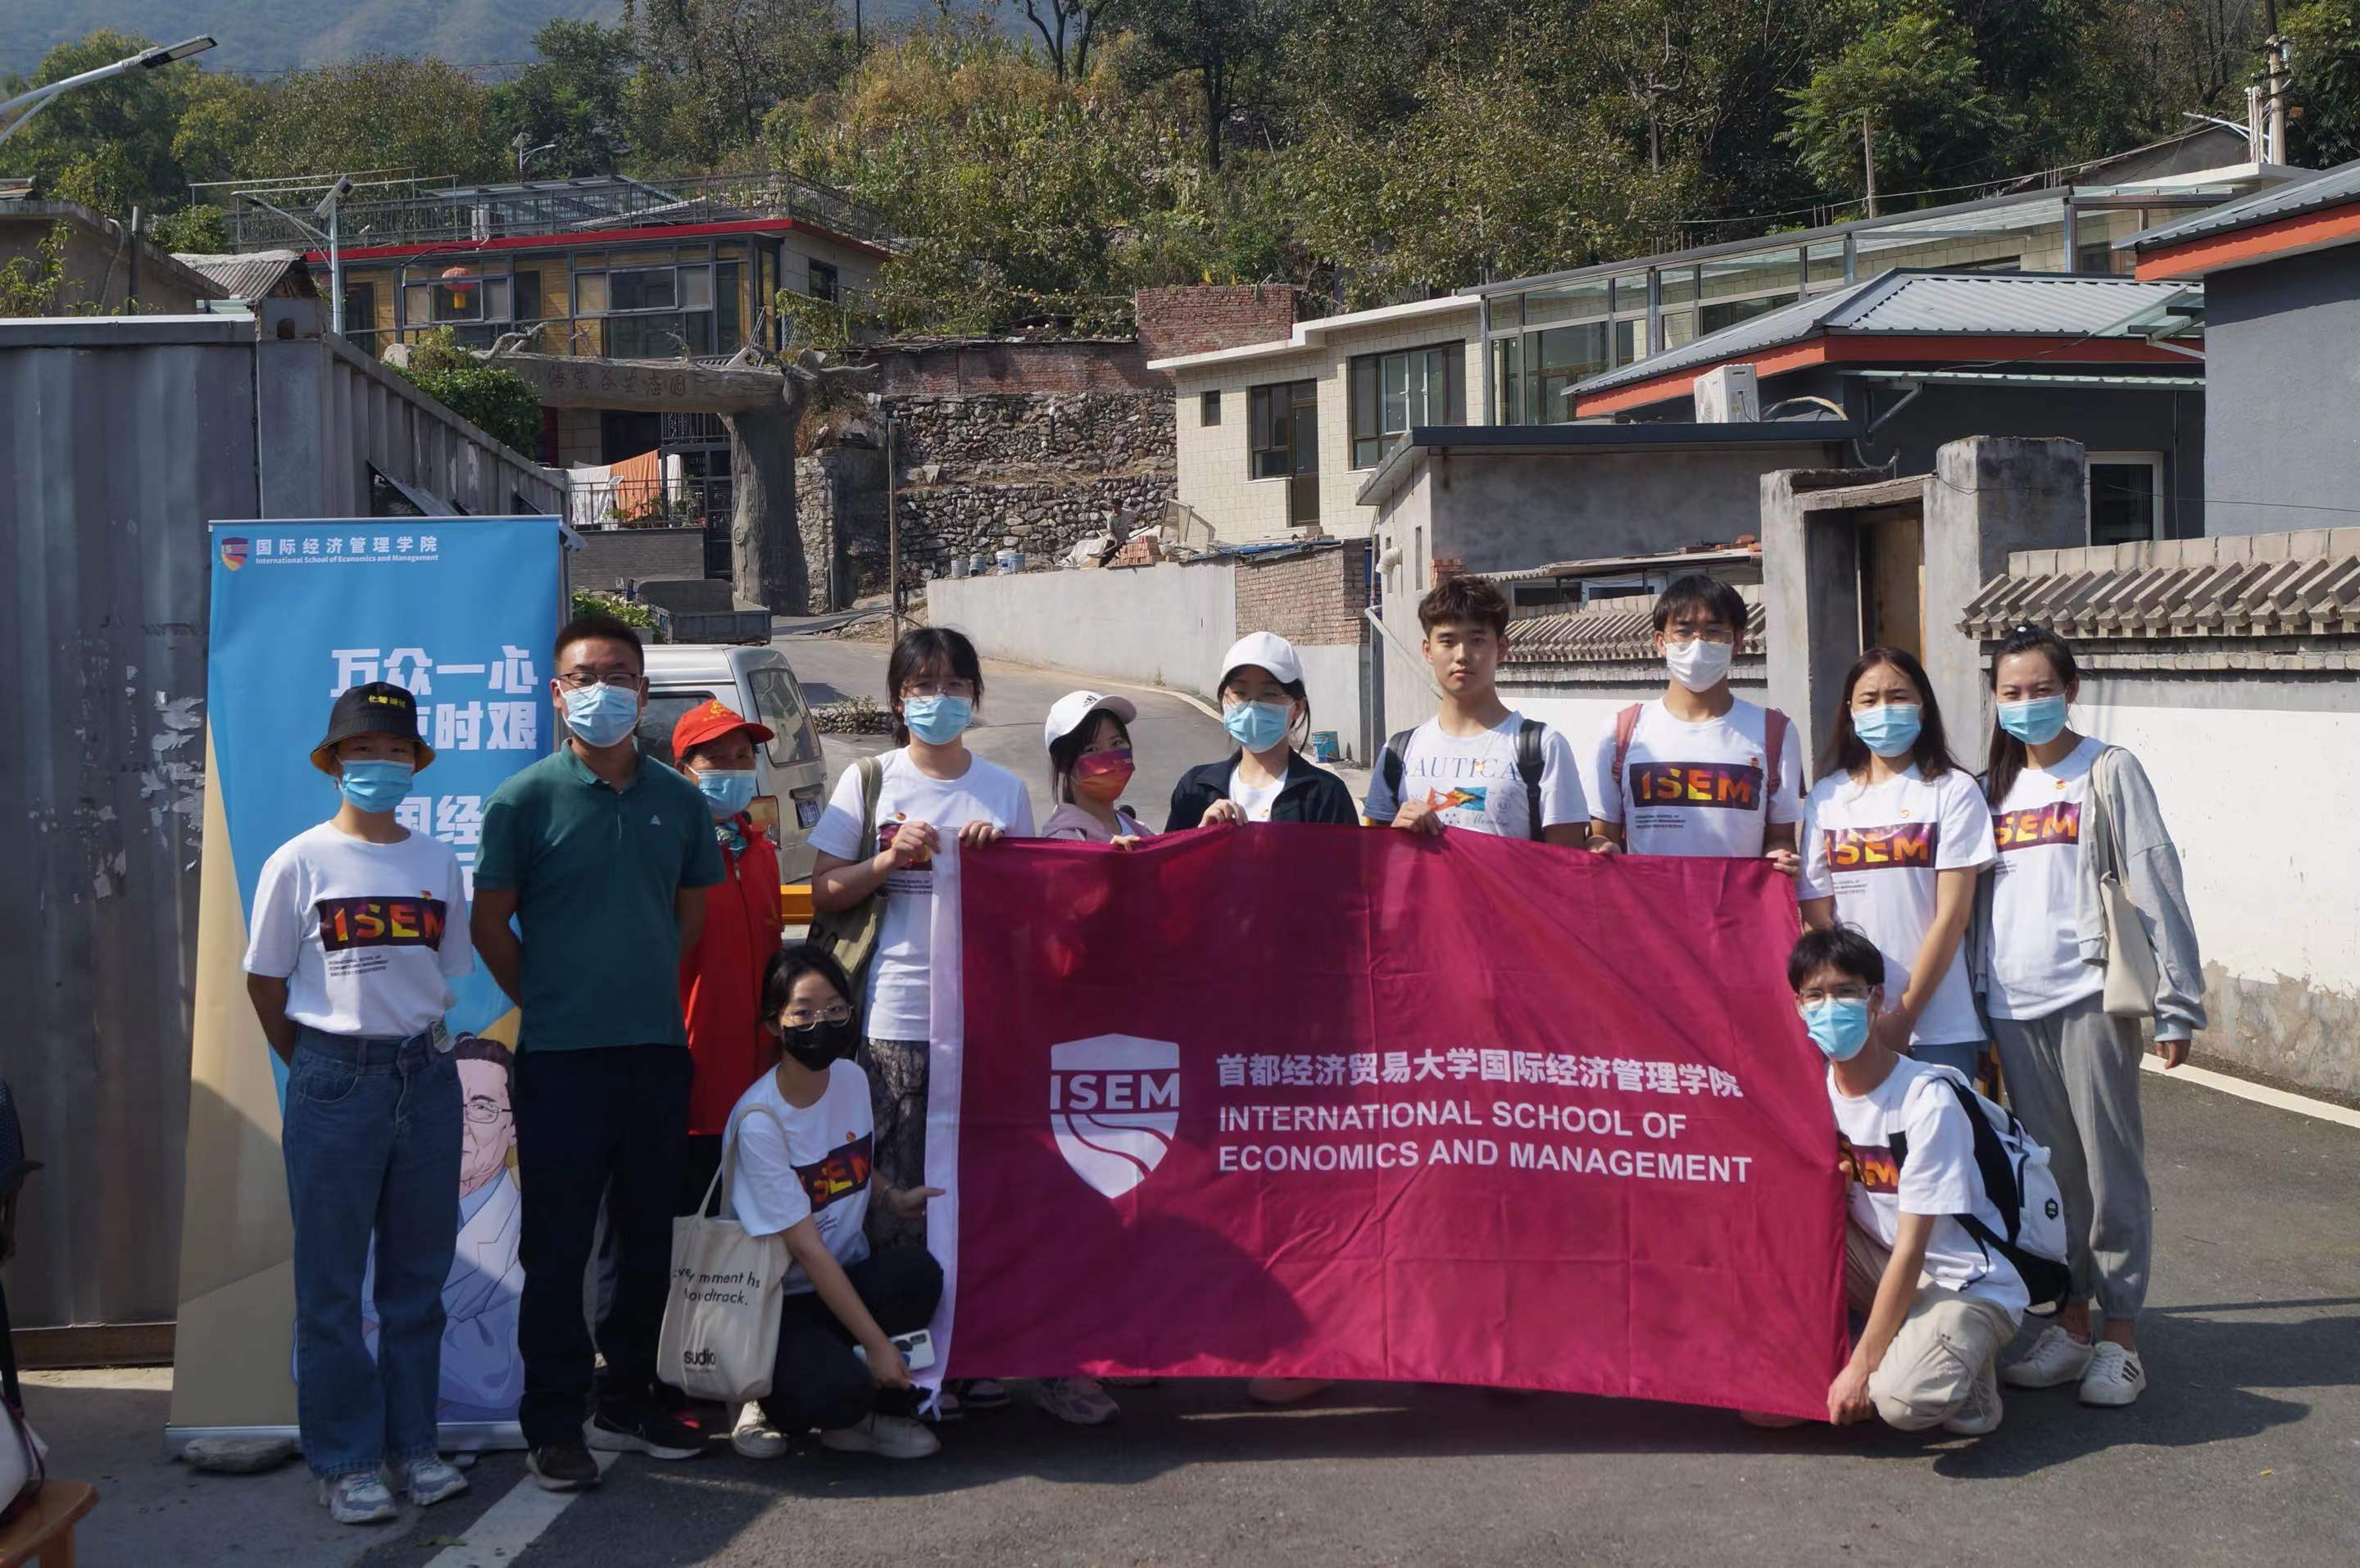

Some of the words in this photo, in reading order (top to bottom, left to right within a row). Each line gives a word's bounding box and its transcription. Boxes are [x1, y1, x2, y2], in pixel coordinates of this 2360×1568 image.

[255, 555, 303, 564] International
[338, 555, 376, 563] Economics
[392, 554, 438, 563] Management
[256, 536, 438, 555] 国际经济管理学院
[330, 645, 538, 697] 万众一心
[1641, 768, 1752, 803] ISEM
[333, 903, 446, 942] ISEM
[1050, 1072, 1180, 1110] ISEM
[1216, 1047, 1744, 1098] 首都经济贸易大学国际经济管理学院
[1219, 1099, 1483, 1132] INTERNATIONAL
[1492, 1101, 1633, 1137] SCHOOL
[1642, 1111, 1687, 1140] OF
[1219, 1140, 1419, 1171] ECONOMICS
[1428, 1139, 1499, 1167] AND
[1509, 1141, 1753, 1183] MANAGEMENT
[699, 1271, 744, 1285] mment
[683, 1348, 716, 1366] sudio
